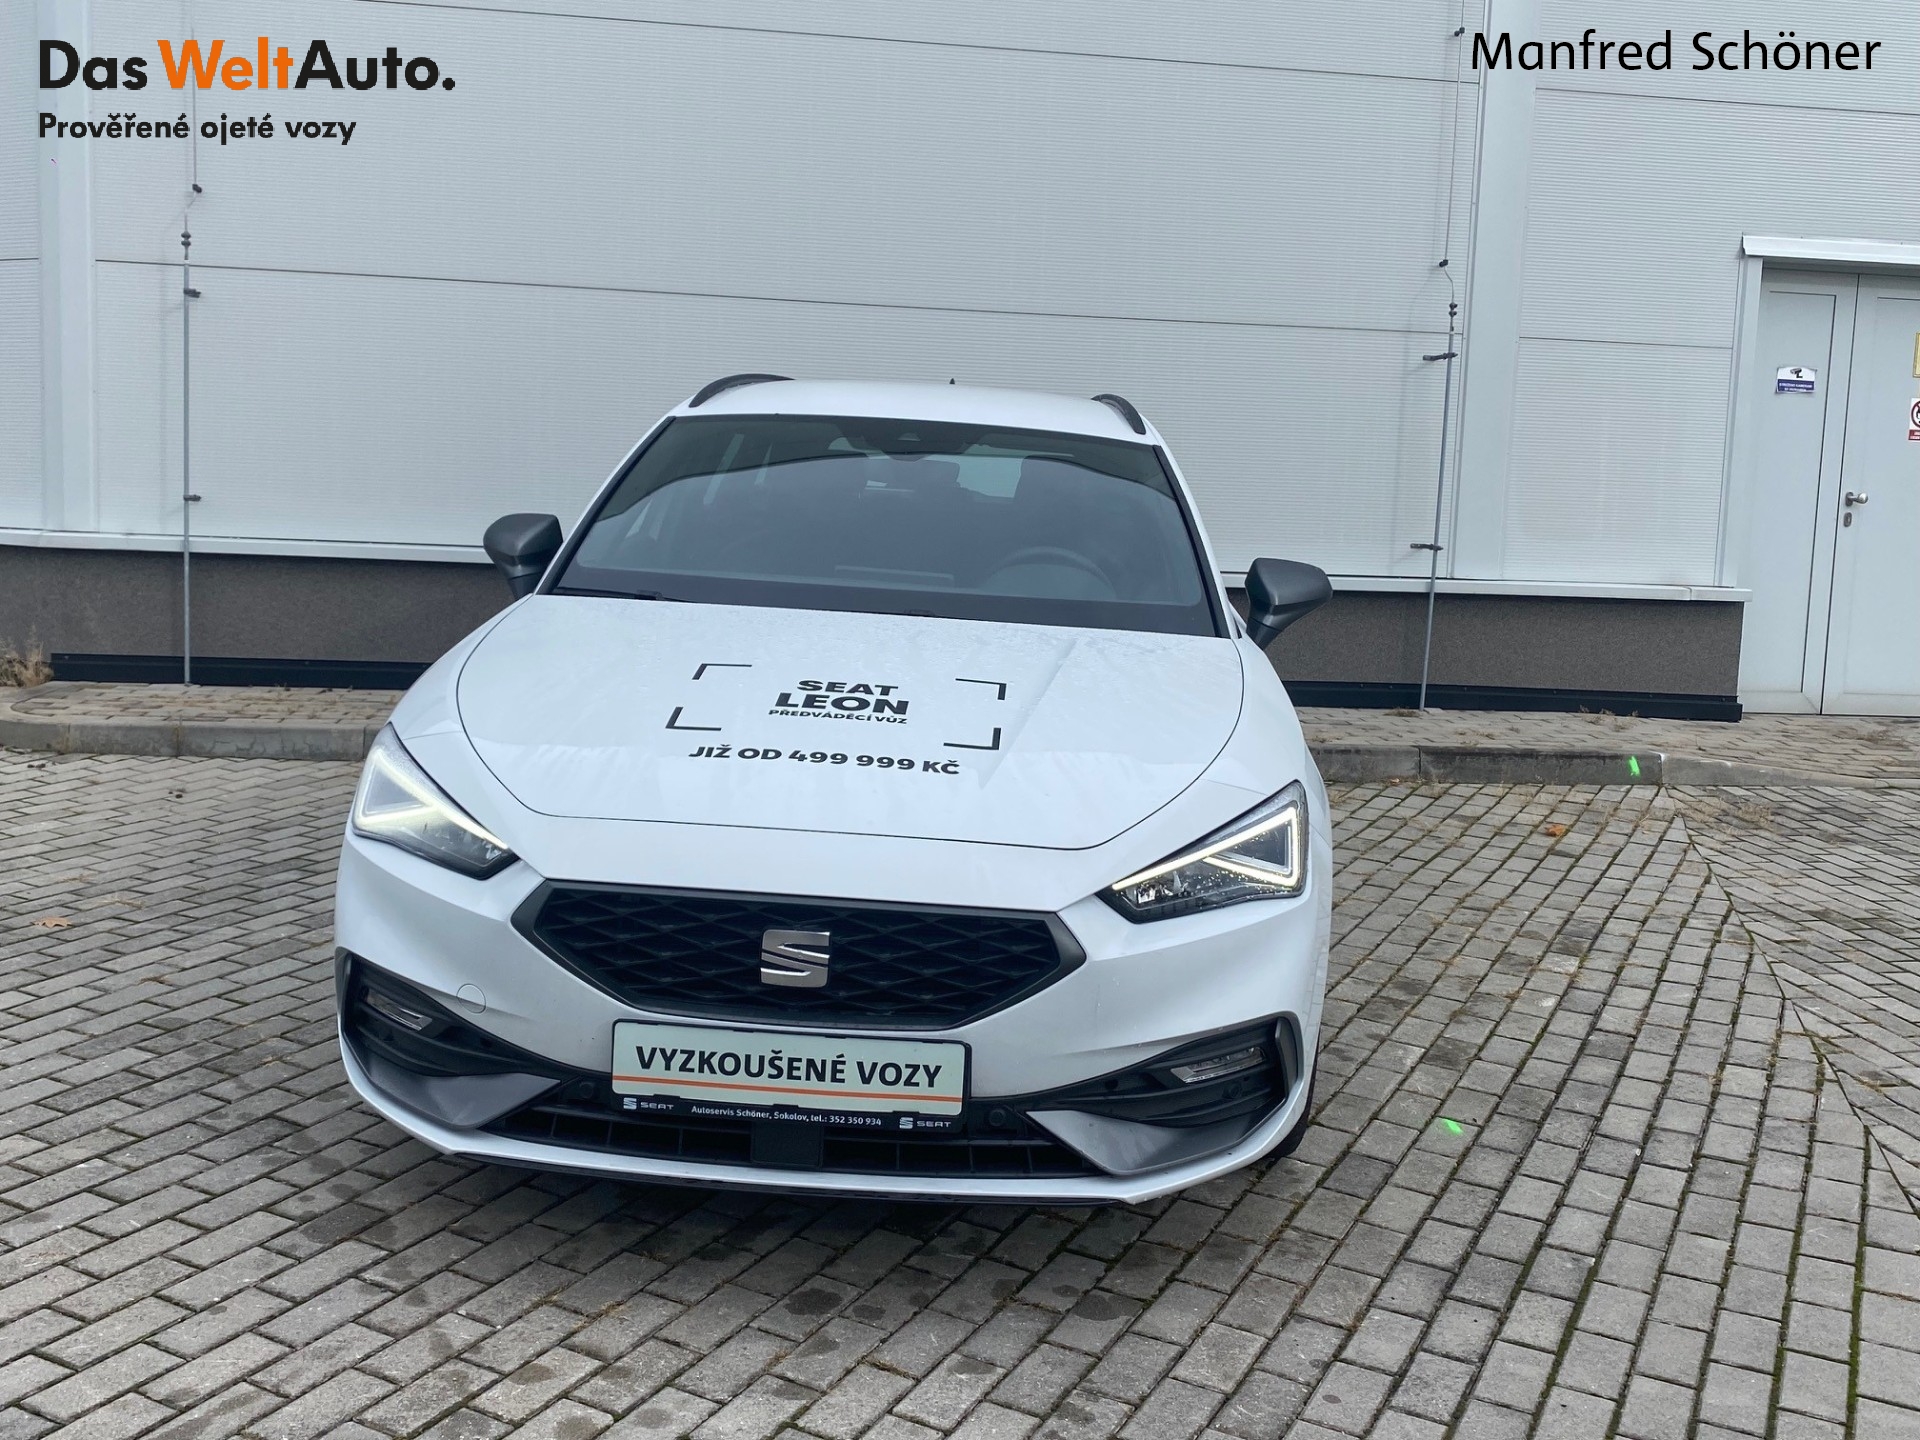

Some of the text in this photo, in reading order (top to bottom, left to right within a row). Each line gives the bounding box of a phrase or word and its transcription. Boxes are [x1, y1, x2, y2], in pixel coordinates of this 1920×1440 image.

[797, 680, 899, 696] SEAT
[775, 692, 909, 715] LEON
[768, 709, 873, 721] PŘEDVÁDĚCÍ
[688, 744, 960, 775] JIŽ OD 499 999 KČ
[635, 1046, 943, 1088] VYZKOUŠENÉ VOZY
[640, 1101, 674, 1110] SEAT
[691, 1105, 882, 1126] Autoservis Schöner, Sokolov, tel.: 352 350 934
[916, 1120, 952, 1128] SEAT
